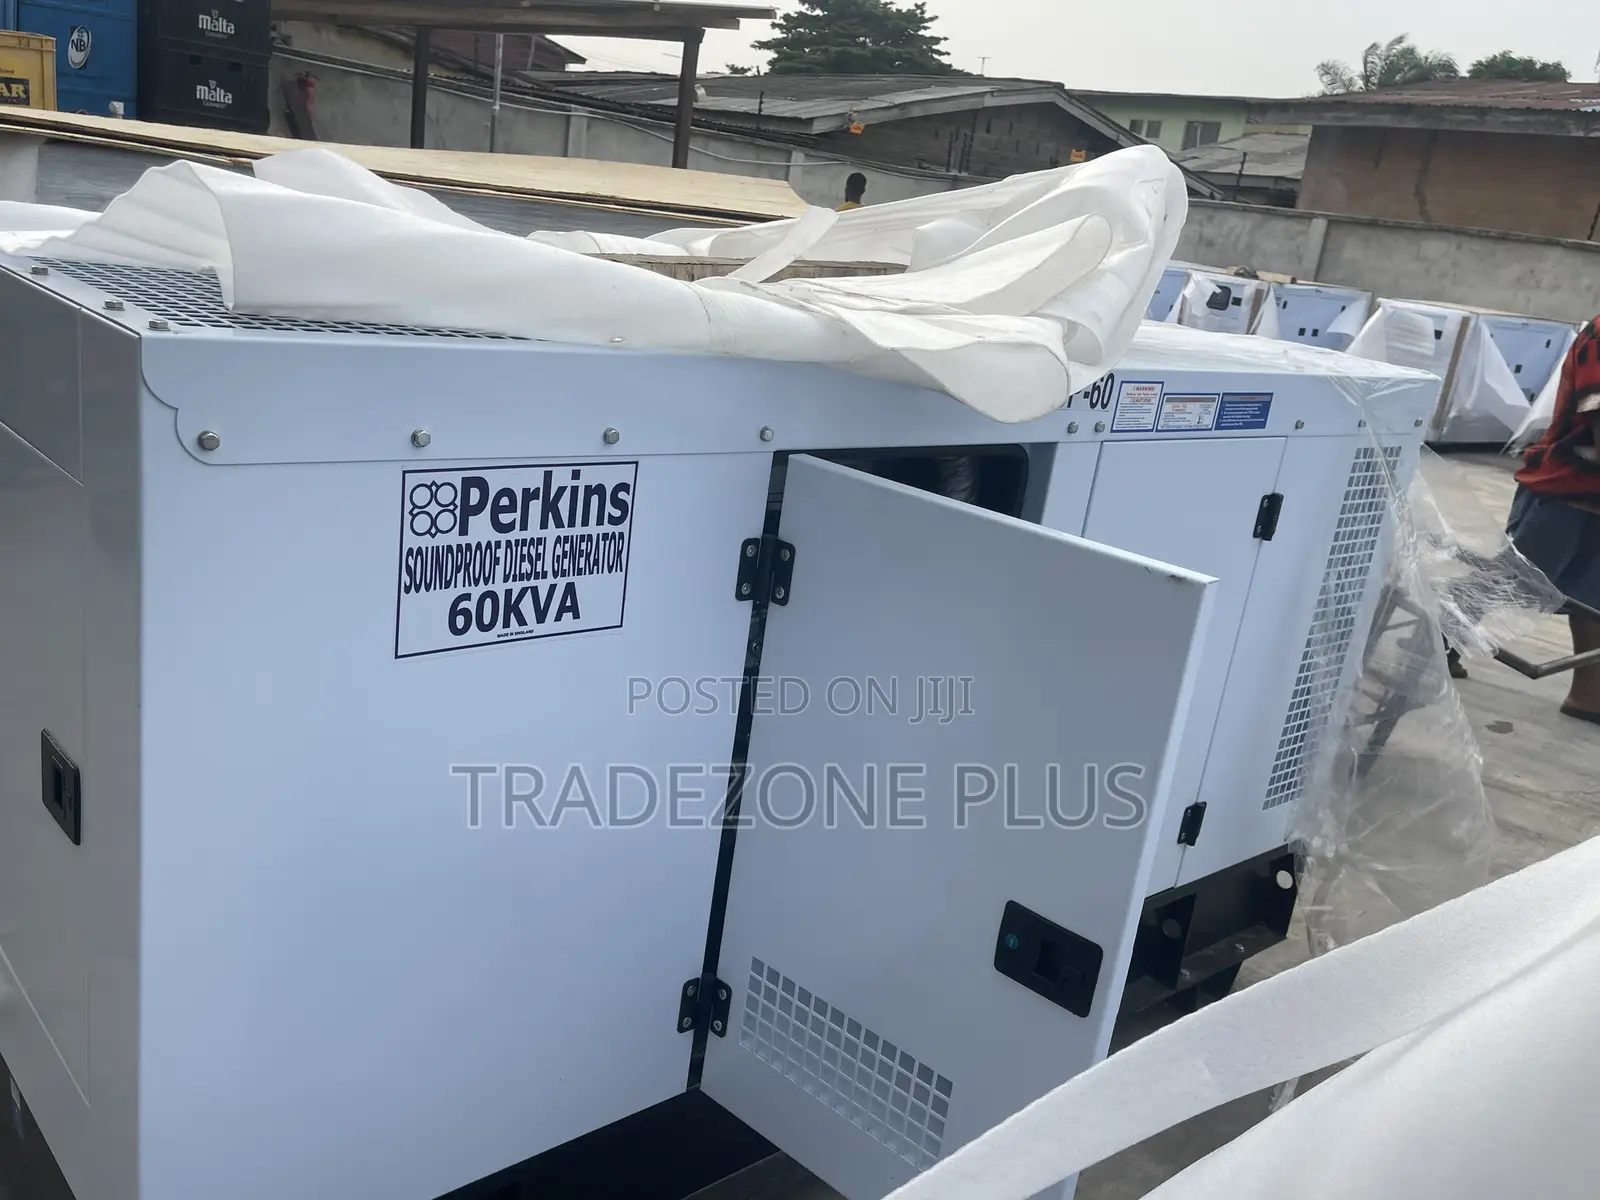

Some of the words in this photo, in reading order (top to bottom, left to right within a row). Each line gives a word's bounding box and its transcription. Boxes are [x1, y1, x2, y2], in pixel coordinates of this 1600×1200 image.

[198, 14, 236, 35] malta
[196, 85, 233, 105] malta
[458, 469, 631, 537] Perkins
[403, 540, 502, 595] SOUNDPROOF
[502, 536, 548, 584] DIESEL
[551, 531, 625, 580] GENERATOR
[447, 581, 581, 637] 60KVA
